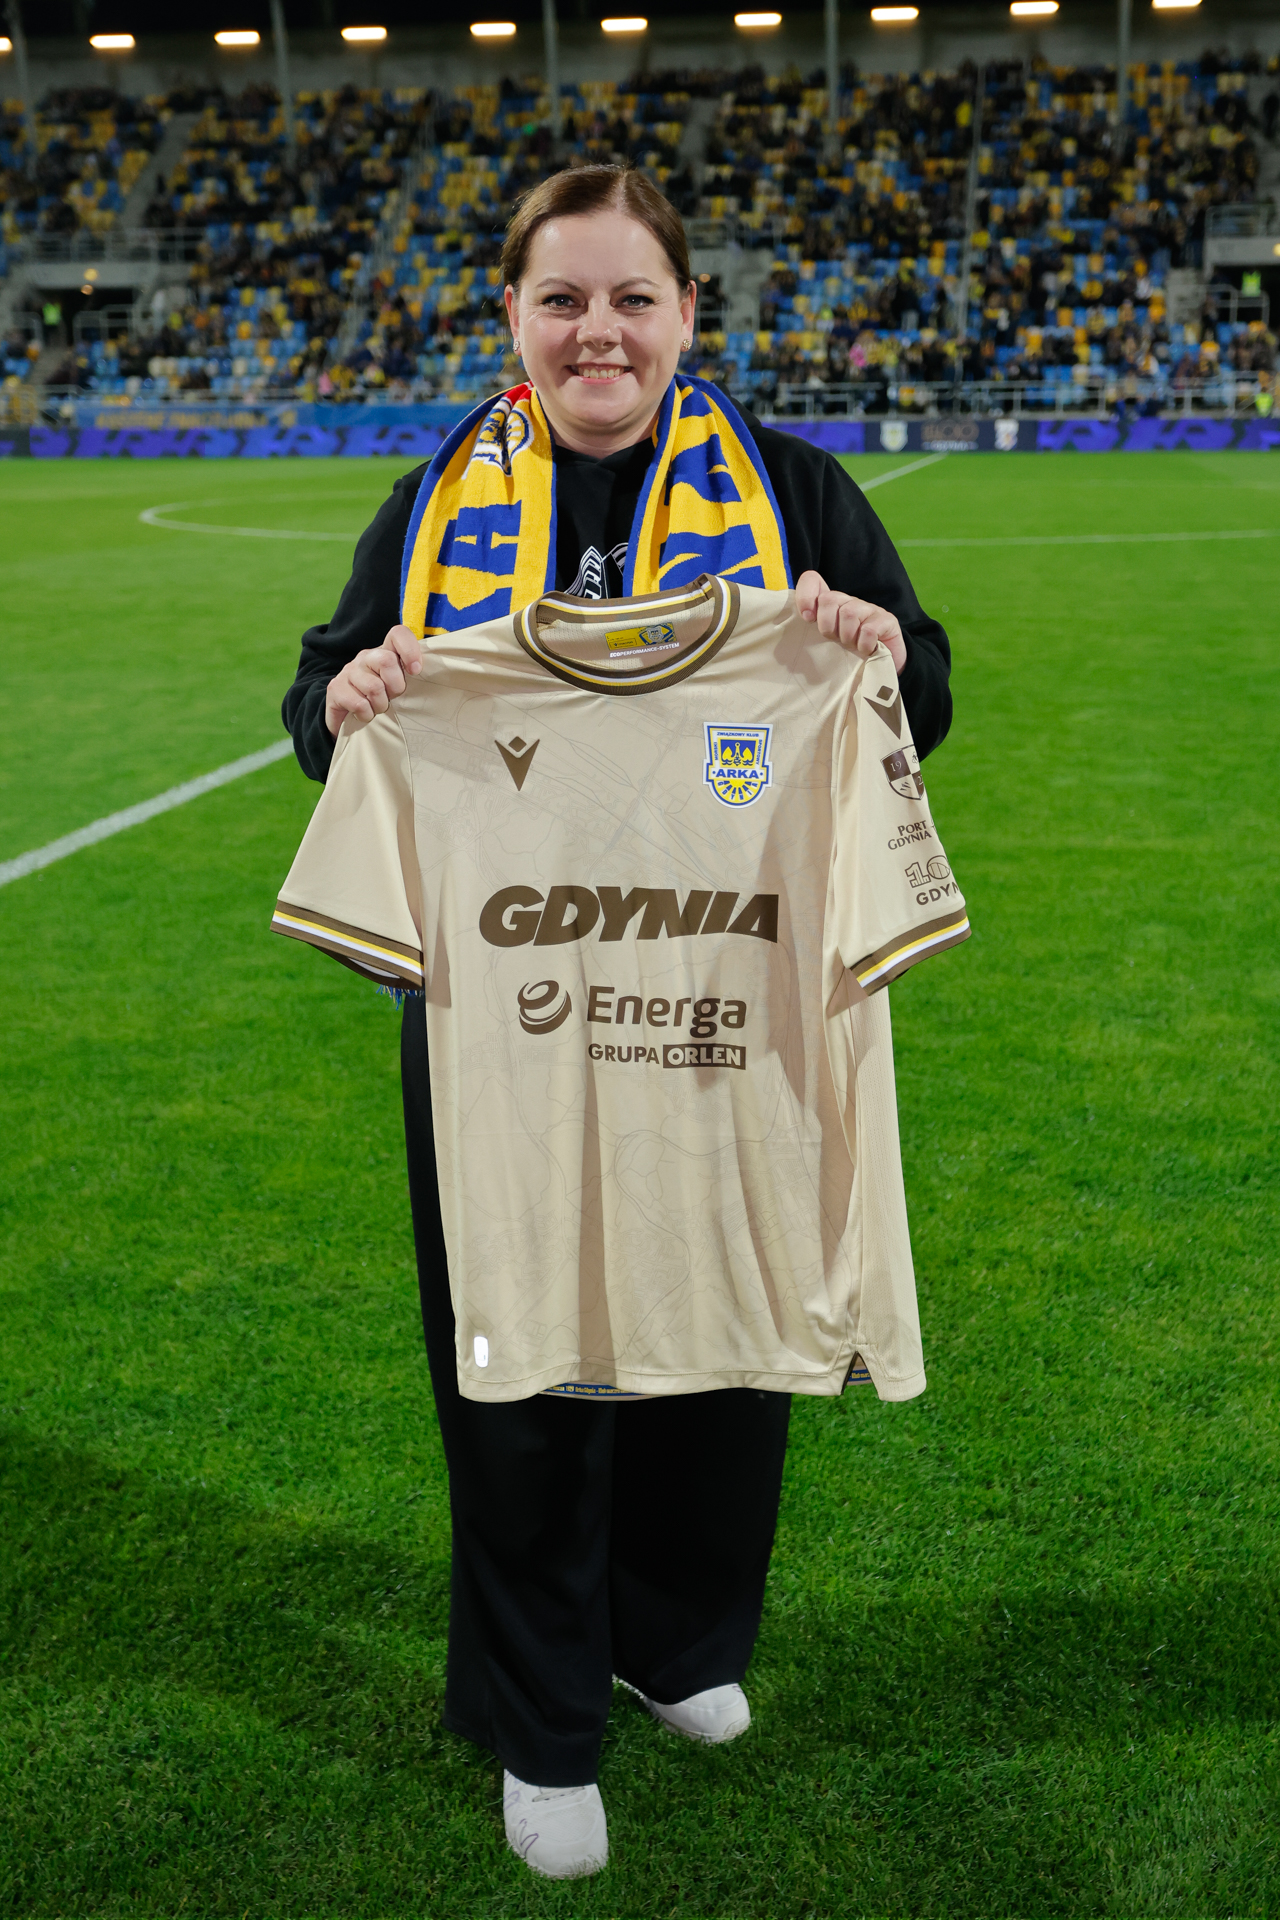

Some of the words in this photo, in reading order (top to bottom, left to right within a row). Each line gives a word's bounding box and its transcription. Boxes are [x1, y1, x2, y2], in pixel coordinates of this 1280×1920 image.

[609, 642, 680, 658] ECOPERFORMANCE-SYSTEM
[716, 768, 759, 779] ARKA
[897, 820, 927, 836] PORT
[887, 830, 932, 850] GDYNIA
[479, 885, 779, 947] GDYNIA
[587, 985, 747, 1038] Energa
[588, 1043, 659, 1064] GRUPA
[667, 1046, 741, 1066] ORLEN
